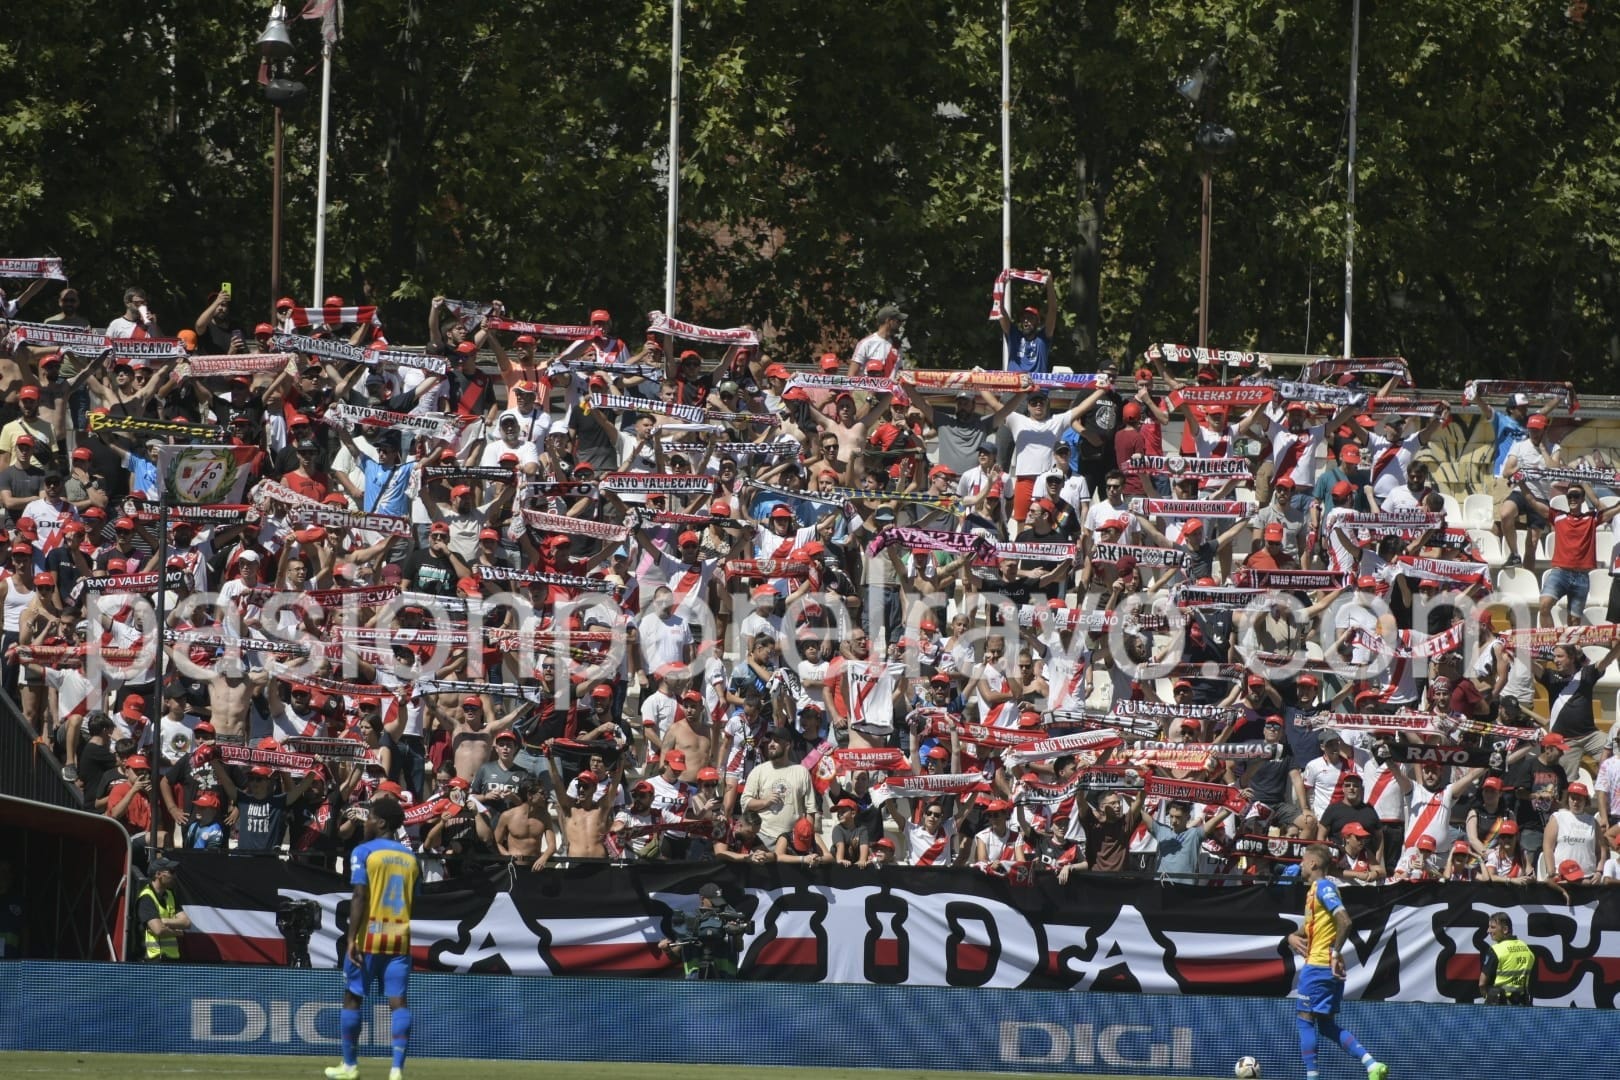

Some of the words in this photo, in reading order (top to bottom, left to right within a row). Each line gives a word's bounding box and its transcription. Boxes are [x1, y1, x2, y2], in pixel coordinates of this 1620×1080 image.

[26, 330, 51, 341] RAYO
[52, 332, 106, 346] VALLECANO
[113, 340, 173, 354] ALLECANO
[1162, 345, 1191, 359] RAYO
[1192, 348, 1254, 364] VALLECANO
[802, 373, 891, 388] VALLECANO
[1030, 373, 1090, 384] ALLECANO
[1178, 389, 1232, 402] VALLEKAS
[1235, 390, 1264, 401] 1924
[342, 404, 372, 418] RAYO
[374, 411, 440, 431] VALLECANO
[608, 476, 639, 489] RAYO
[643, 476, 709, 489] VALLECANO
[143, 502, 173, 515] Rao
[177, 504, 240, 519] Vallecano
[1354, 512, 1377, 523] RAYO
[1379, 513, 1426, 523] VALLECANO
[1014, 542, 1069, 555] VALLECANO
[1091, 544, 1143, 564] RKING
[1412, 557, 1433, 572] RAYO
[87, 578, 116, 589] RAYO
[117, 571, 183, 587] VALLECNO
[1181, 588, 1207, 603] RAYO
[1018, 609, 1049, 622] RAYO
[1051, 610, 1119, 626] VALLECANO
[1336, 713, 1363, 725] RAYO
[1366, 715, 1429, 728] VALLECANO
[1033, 739, 1057, 753] RAYO
[1406, 747, 1470, 764] RAYO
[903, 778, 925, 791] RAYO
[404, 800, 438, 819] ALLECA
[382, 873, 405, 915] 4
[999, 1020, 1192, 1069] DIGI
